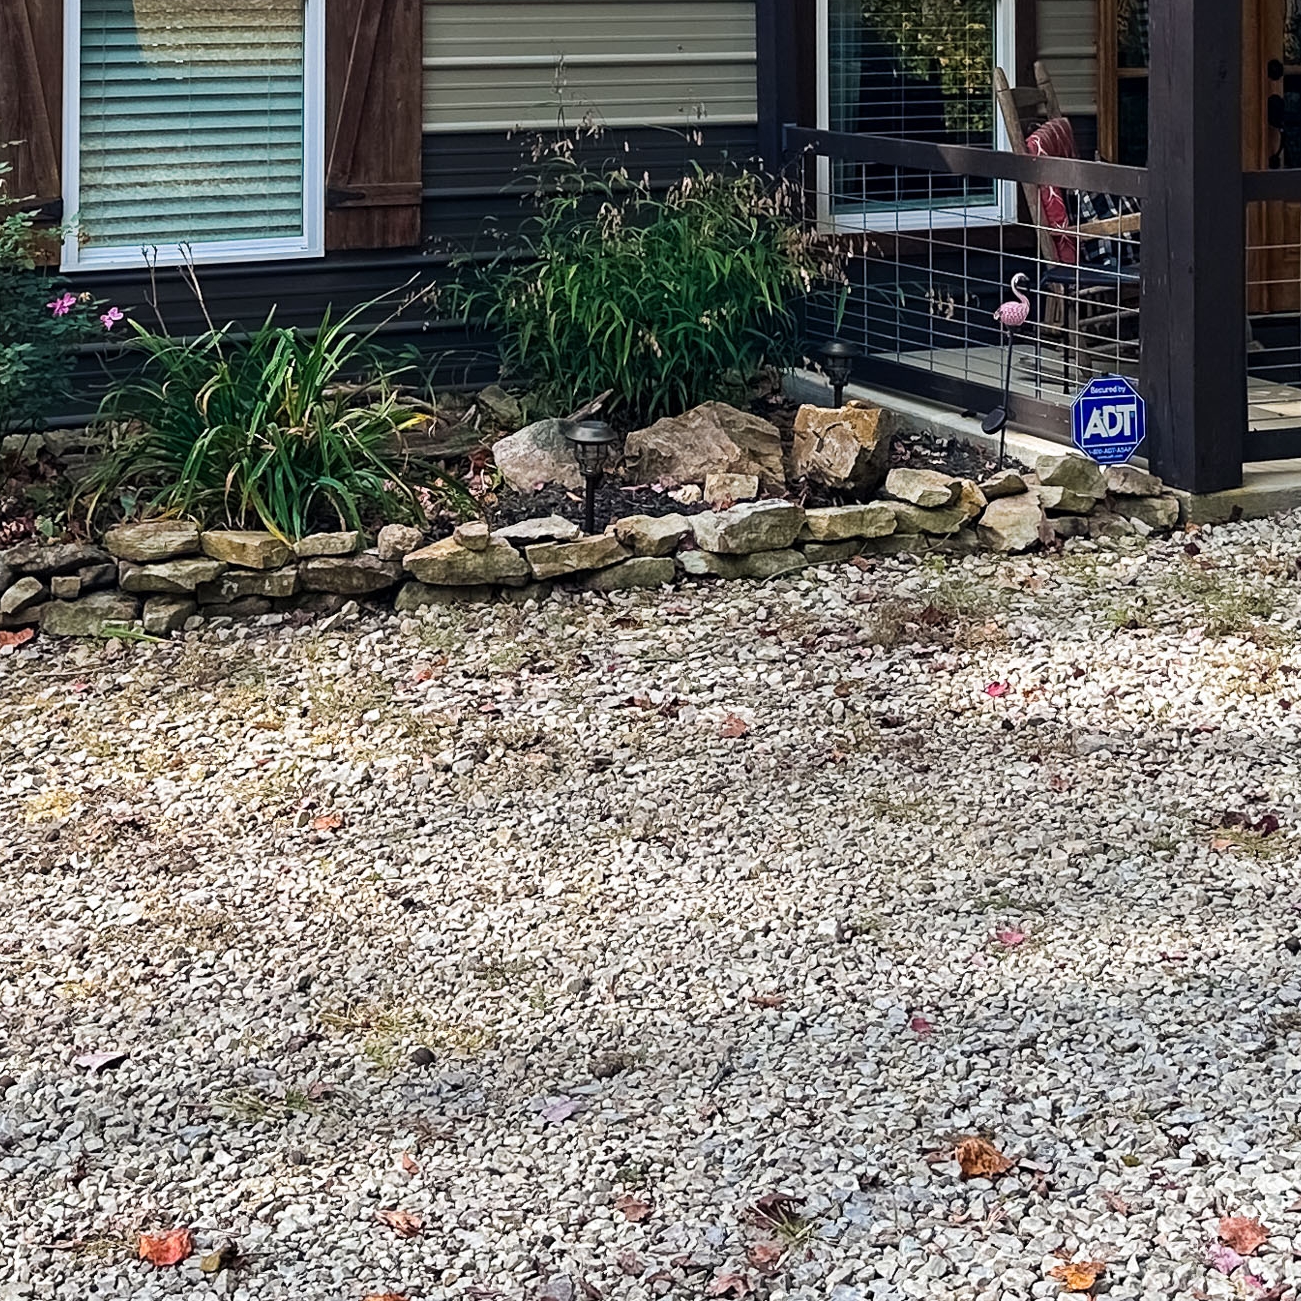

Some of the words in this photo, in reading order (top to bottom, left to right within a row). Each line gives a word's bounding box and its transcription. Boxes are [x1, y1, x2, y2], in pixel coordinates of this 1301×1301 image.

[1090, 386, 1117, 394] Secured
[1118, 385, 1126, 393] by
[1083, 404, 1136, 439] ADT
